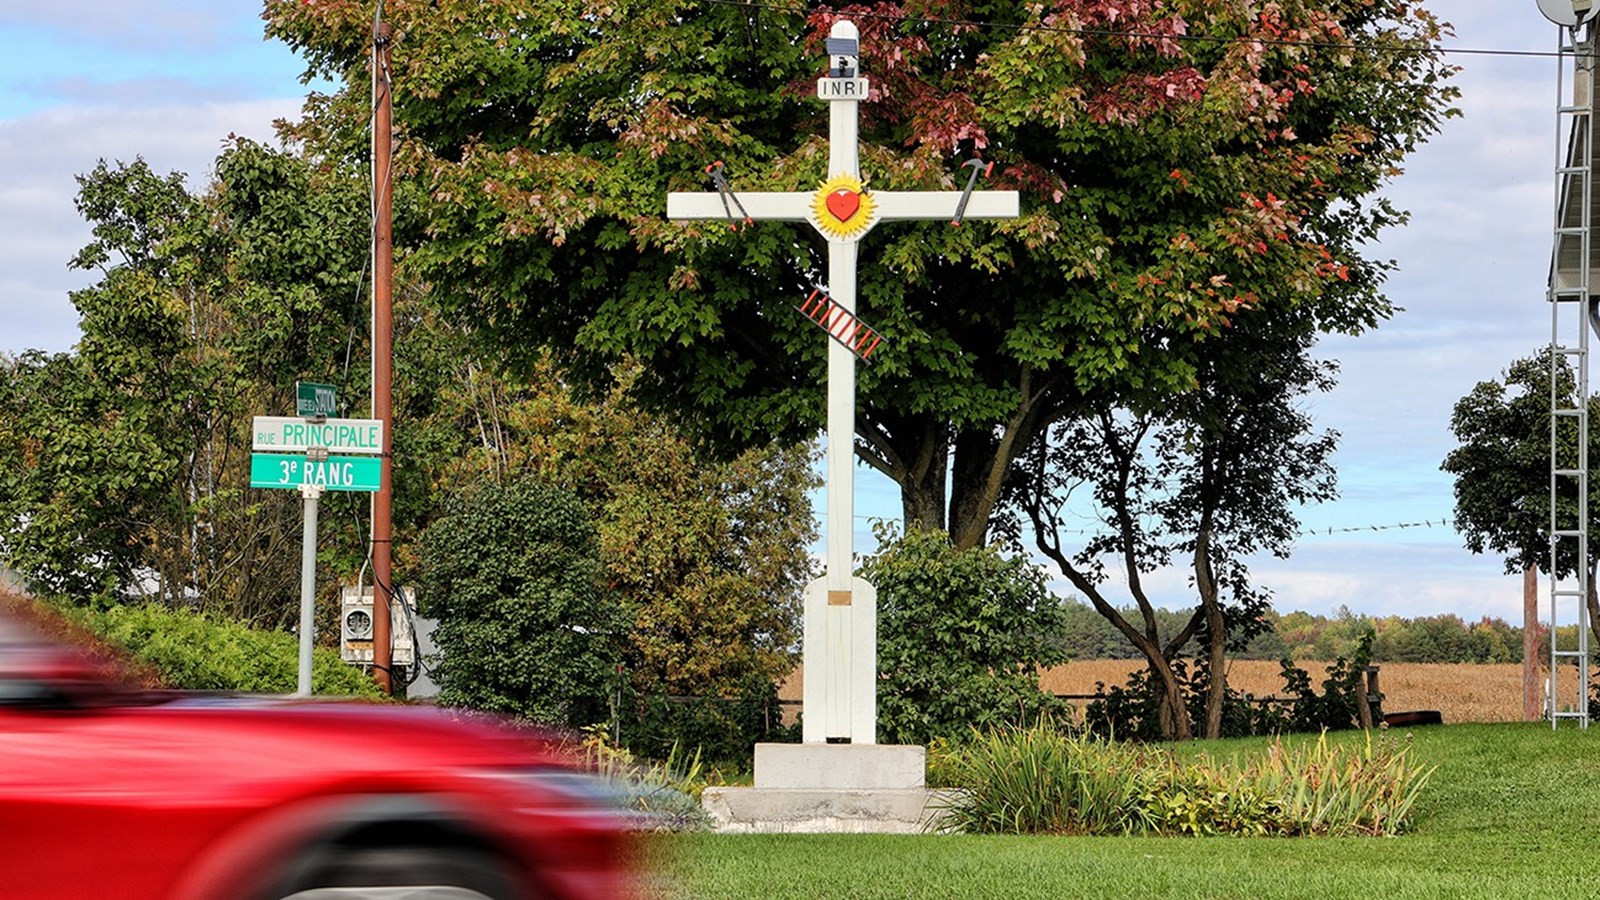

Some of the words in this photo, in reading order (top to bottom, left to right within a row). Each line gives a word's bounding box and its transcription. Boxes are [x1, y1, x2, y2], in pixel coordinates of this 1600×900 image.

[823, 81, 863, 95] INRI
[257, 432, 276, 445] RUE
[283, 424, 378, 448] PRINCIPALE
[304, 461, 354, 486] RANG
